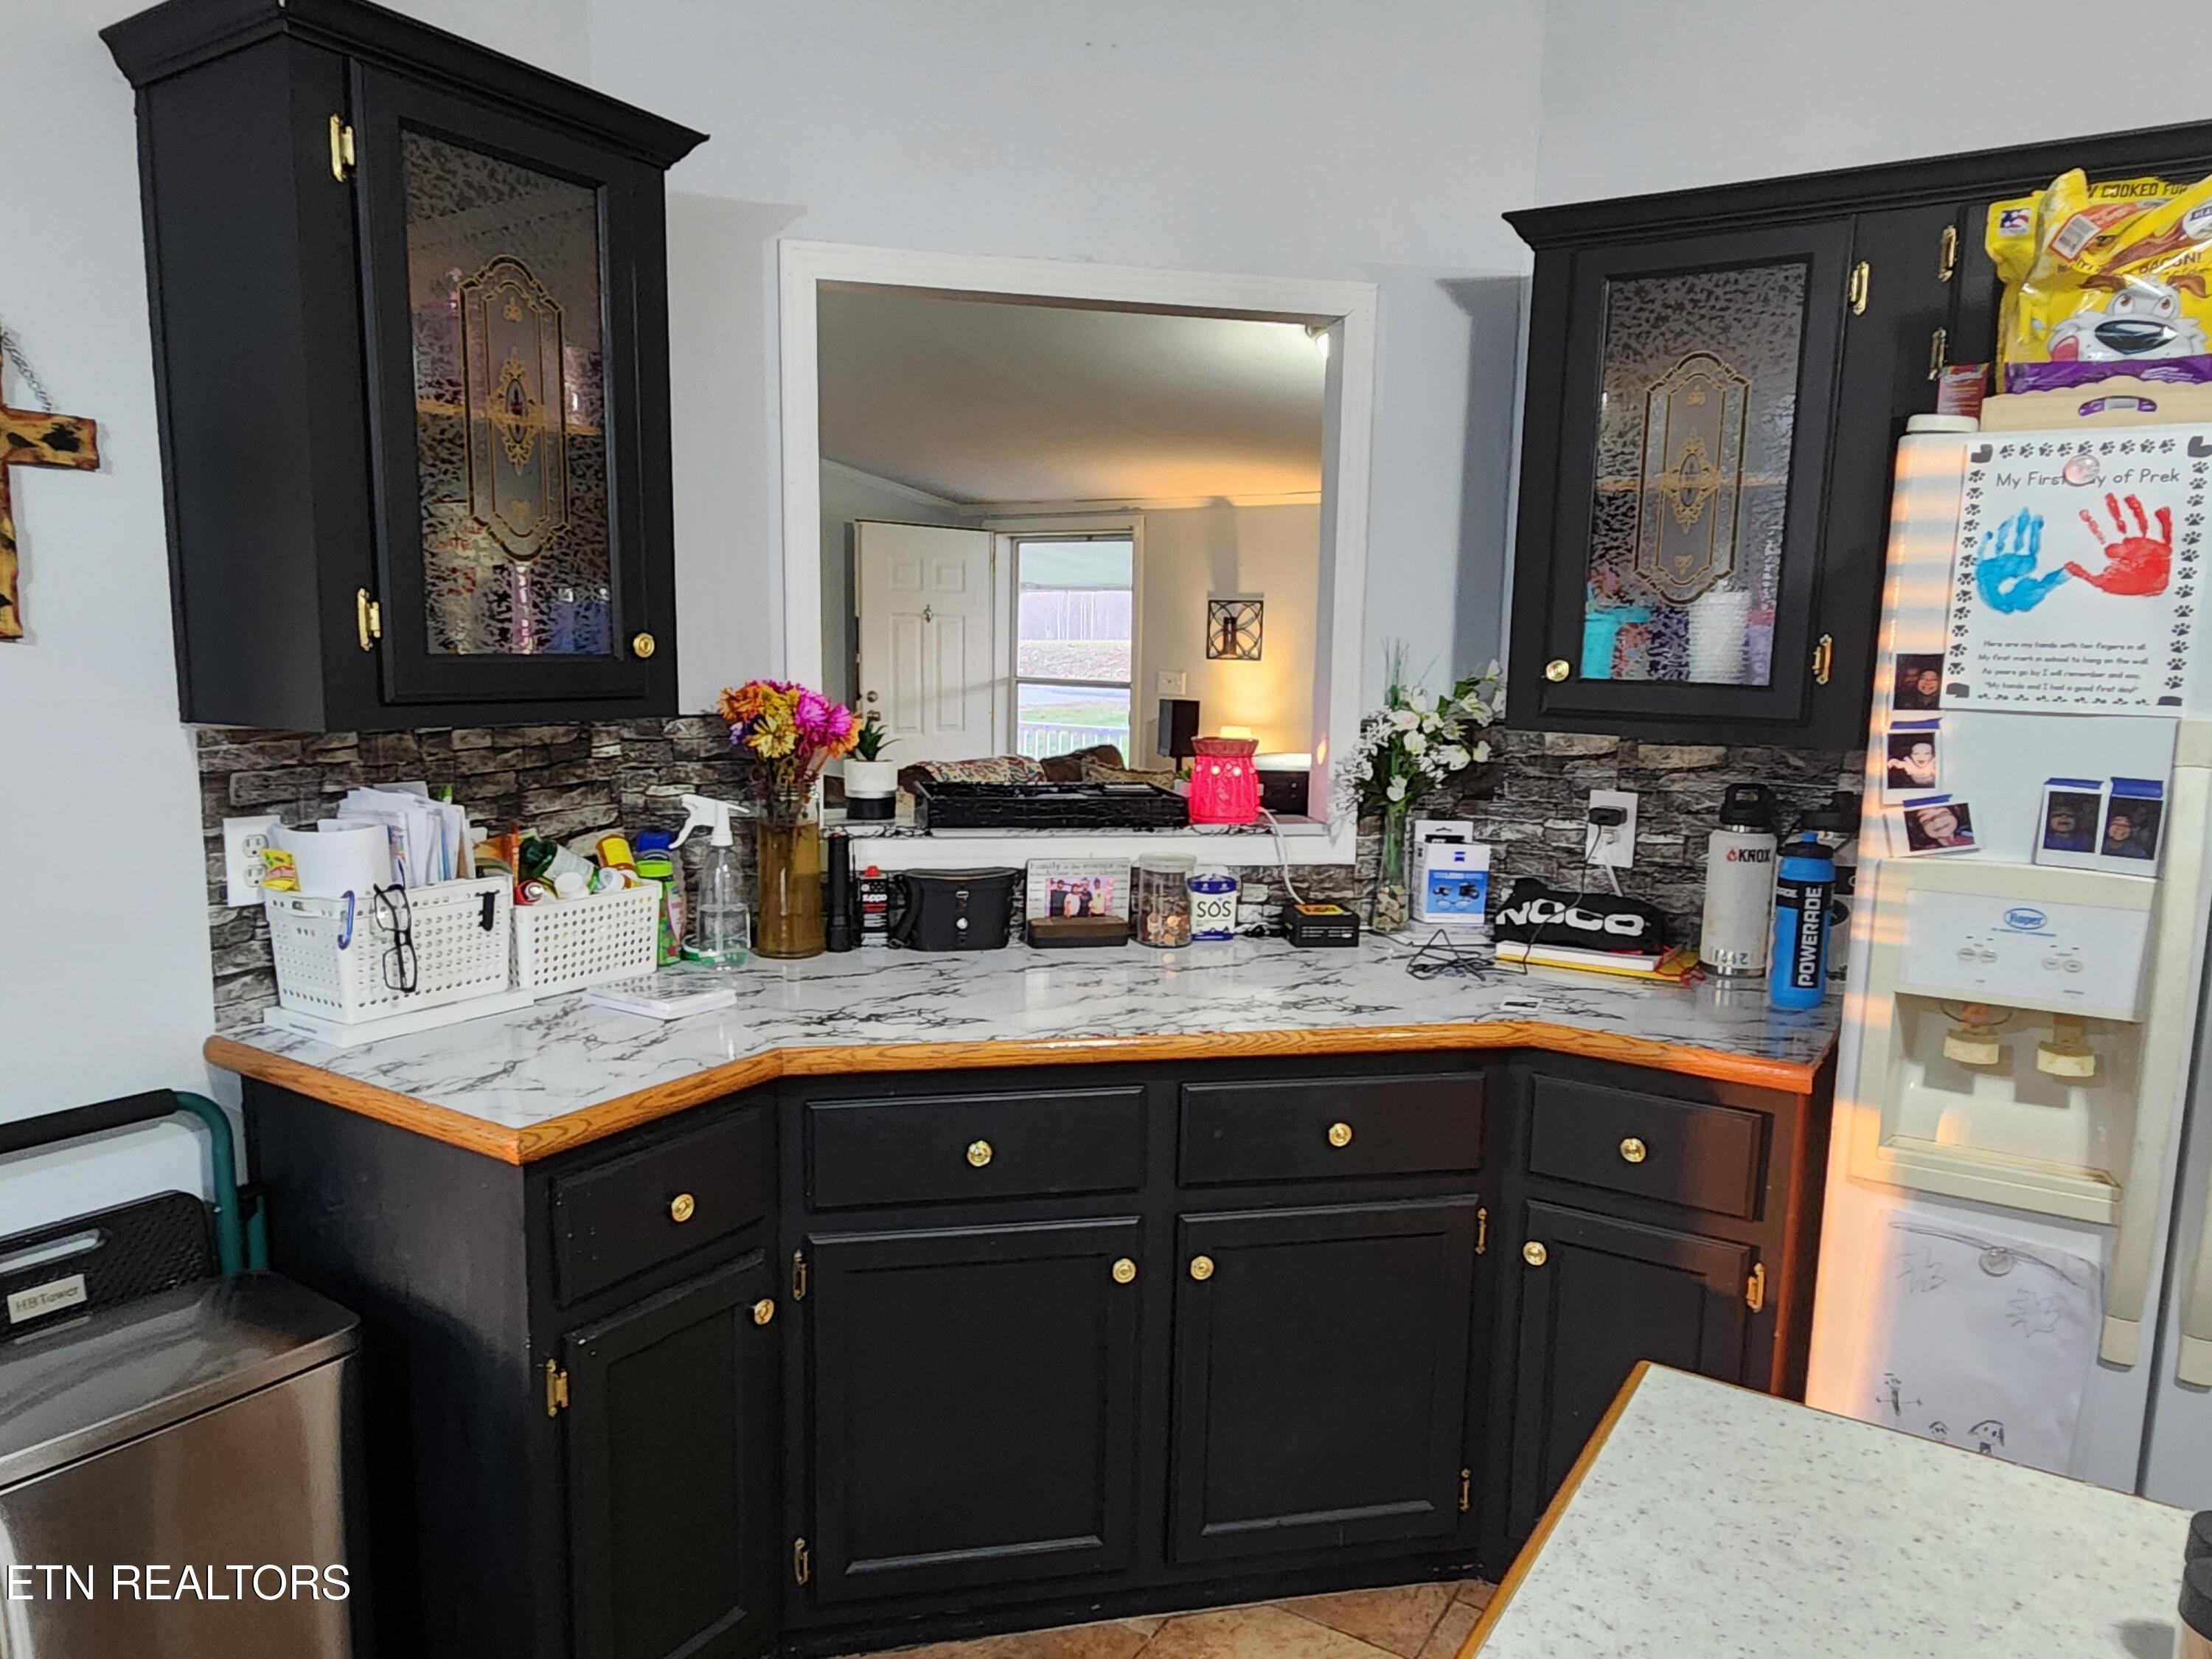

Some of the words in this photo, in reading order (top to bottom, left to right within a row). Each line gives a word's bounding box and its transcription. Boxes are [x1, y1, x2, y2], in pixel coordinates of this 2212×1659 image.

[2101, 183, 2160, 198] COOKED
[1995, 472, 2022, 490] My
[2112, 468, 2135, 484] of
[2139, 467, 2180, 484] Prek
[1738, 849, 1771, 863] KNOX
[1196, 900, 1232, 919] SOS
[1797, 886, 1823, 987] POWERADE
